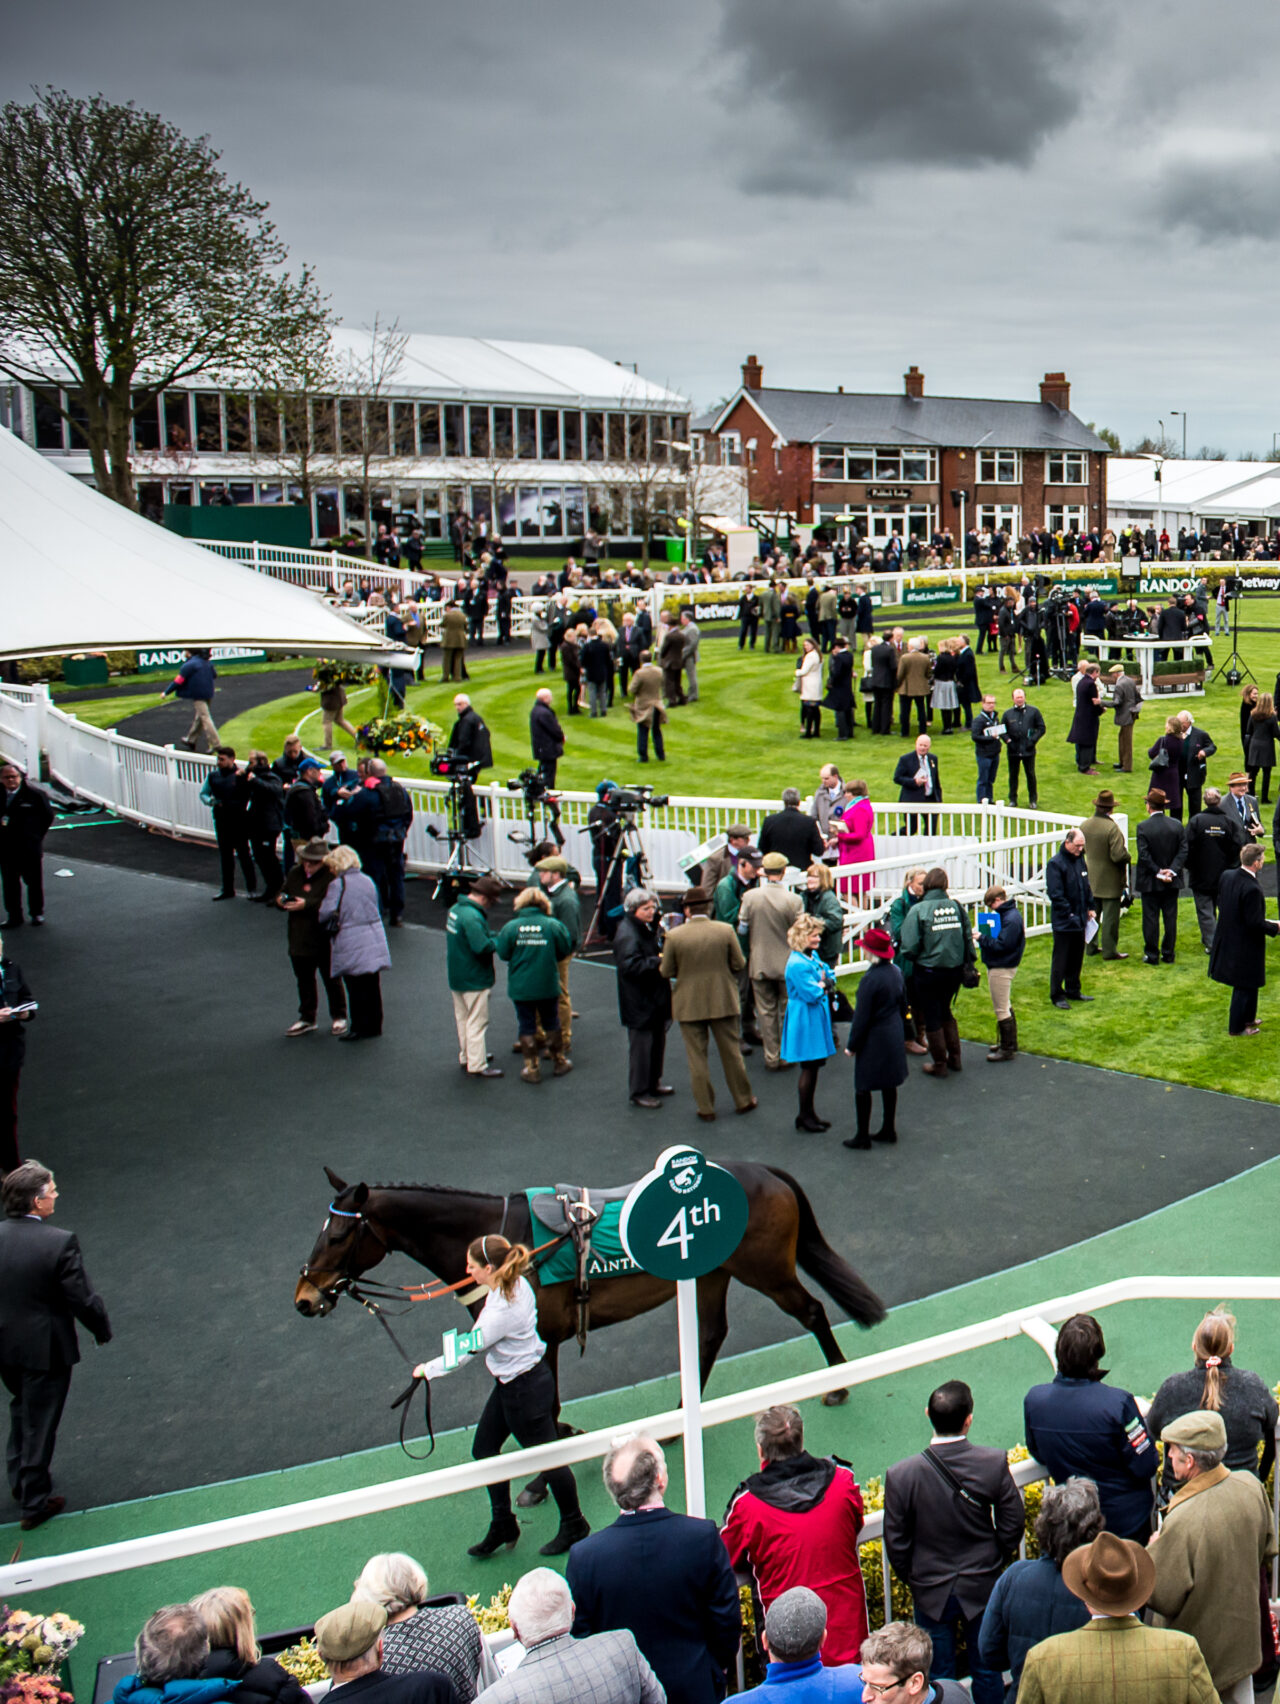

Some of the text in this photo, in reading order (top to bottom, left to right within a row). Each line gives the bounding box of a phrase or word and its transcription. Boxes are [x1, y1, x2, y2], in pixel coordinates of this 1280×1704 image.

[1139, 578, 1200, 593] RANDOX
[695, 603, 740, 620] betway
[139, 650, 187, 666] RAND
[656, 1197, 721, 1260] 4th
[459, 1338, 470, 1350] 2
